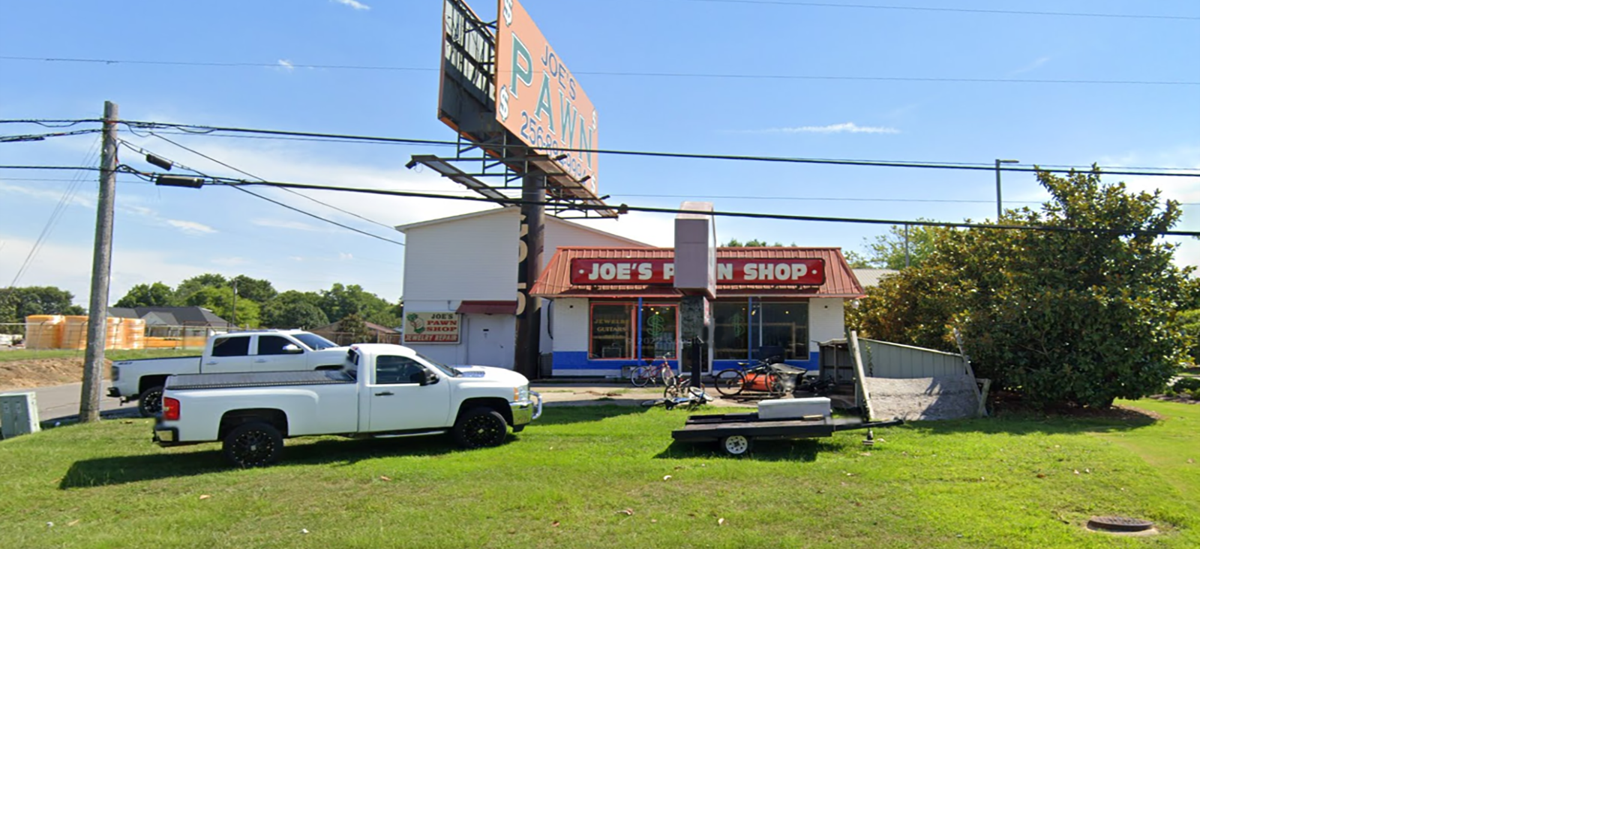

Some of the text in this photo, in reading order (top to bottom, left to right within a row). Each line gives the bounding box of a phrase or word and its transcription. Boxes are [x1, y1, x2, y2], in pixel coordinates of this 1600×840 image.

[541, 45, 576, 100] JOE'S
[509, 31, 593, 171] PAWN
[588, 263, 808, 280] JOE'S PN SHOP
